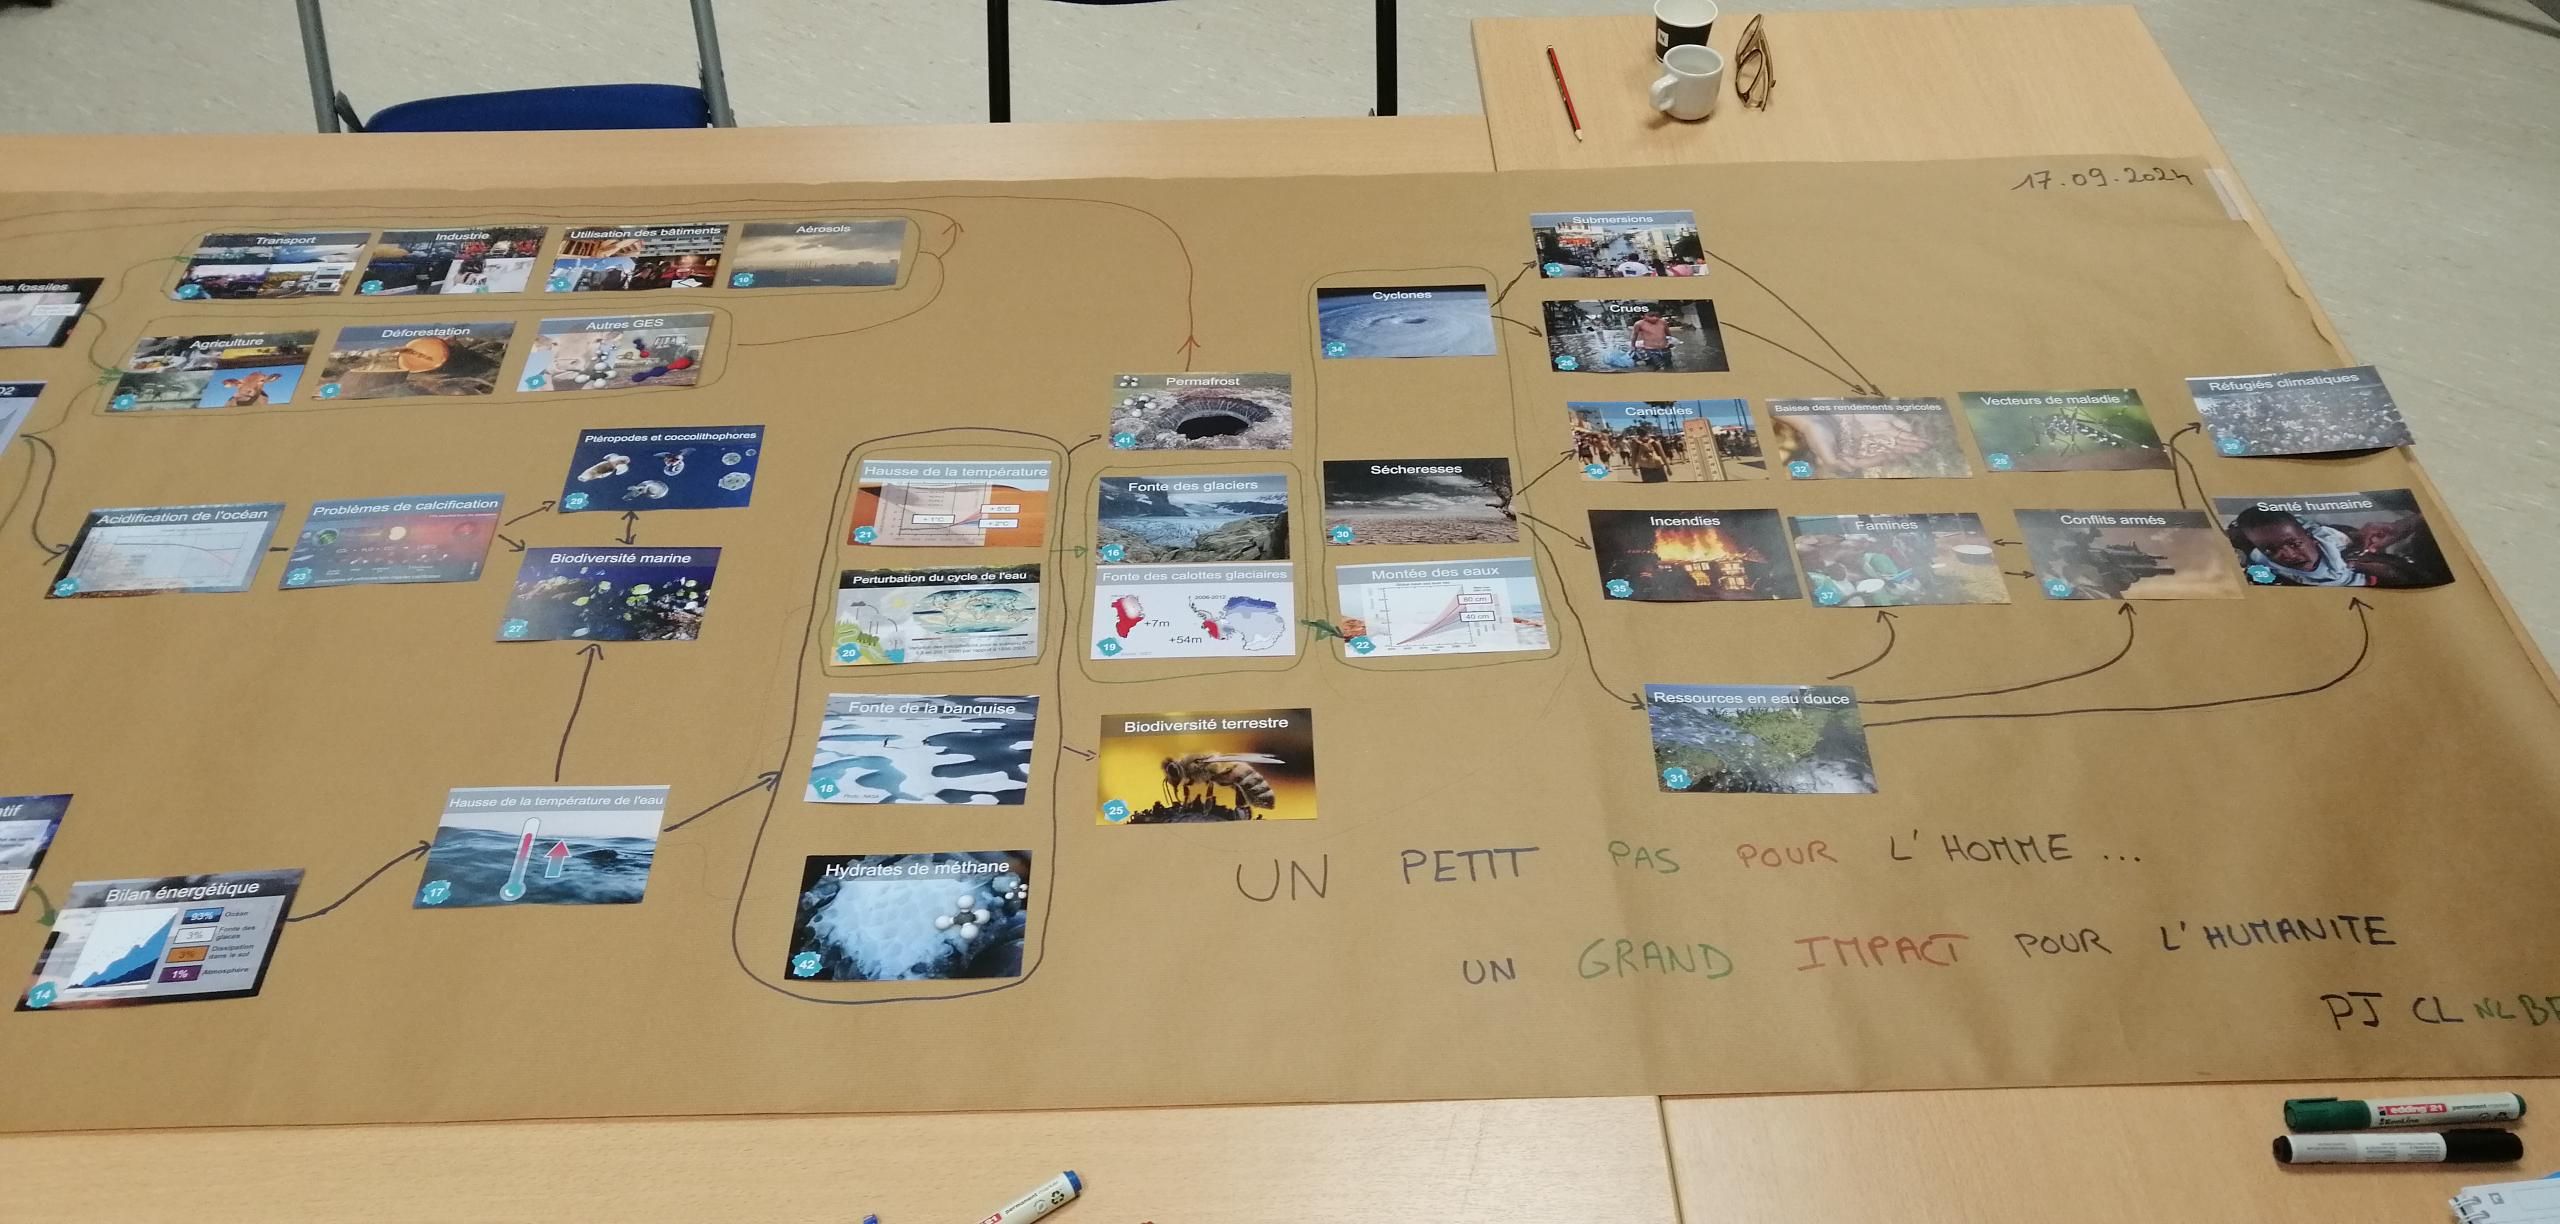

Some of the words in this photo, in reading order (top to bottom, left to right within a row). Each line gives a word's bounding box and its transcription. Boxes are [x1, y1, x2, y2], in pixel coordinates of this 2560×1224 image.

[1573, 215, 1654, 225] Submersions
[570, 228, 635, 239] Utilisation
[638, 228, 657, 238] des
[660, 225, 721, 237] bâtiments
[796, 224, 850, 234] Aérosols
[435, 231, 490, 241] Industrie
[256, 236, 316, 248] Transport
[738, 276, 749, 284] 10
[18, 283, 69, 292] fossiles
[1372, 291, 1432, 300] Cyclones
[1610, 304, 1649, 313] Crues
[586, 320, 629, 330] Autres
[633, 318, 664, 328] GES
[381, 326, 470, 338] Déforestation
[190, 337, 264, 351] Agriculture
[1166, 377, 1240, 386] Permafrost
[2209, 380, 2273, 392] Réfugiés
[2277, 374, 2360, 389] climatiques
[1980, 396, 2042, 406] Vecteurs
[2044, 395, 2063, 405] de
[2066, 394, 2120, 404] maladie
[1625, 406, 1693, 417] Canicules
[1775, 404, 1810, 412] Baisse
[1833, 403, 1893, 411] rendements
[1896, 403, 1942, 412] agricoles
[584, 433, 648, 445] Ptéropodes
[650, 433, 662, 442] et
[664, 431, 757, 443] coccolithophores
[864, 466, 919, 477] Hausse
[921, 466, 941, 477] de
[945, 466, 958, 477] la
[961, 466, 1048, 479] température
[1371, 464, 1463, 475] Sécheresses
[1128, 482, 1169, 492] Fonte
[1173, 481, 1199, 491] des
[1203, 480, 1258, 492] glaciers
[569, 497, 584, 505] 29
[2256, 501, 2302, 513] Santé
[2305, 499, 2373, 512] humaine
[312, 505, 389, 516] Problèmes
[393, 502, 412, 512] de
[415, 499, 498, 511] calcification
[96, 511, 188, 525] Acidification
[191, 510, 213, 522] de
[216, 508, 268, 521] l'océan
[1650, 515, 1720, 527] Incendies
[2060, 514, 2117, 525] Conflits
[2120, 515, 2167, 525] armés
[1856, 519, 1918, 532] Famines
[550, 552, 636, 565] Biodiversité
[640, 553, 692, 564] marine
[1108, 549, 1120, 557] 16
[292, 573, 307, 581] 23
[853, 574, 926, 585] Perturbation
[928, 573, 945, 583] du
[947, 572, 977, 583] cycle
[980, 572, 996, 581] de
[999, 571, 1027, 581] l'eau
[1103, 572, 1140, 582] Fonte
[1144, 571, 1167, 581] des
[1170, 570, 1222, 581] calottes
[1225, 569, 1288, 581] glaciaires
[1371, 567, 1427, 580] Montée
[1431, 567, 1459, 578] des
[1463, 566, 1500, 576] eaux
[59, 583, 74, 592] 24
[1612, 584, 1627, 593] 35
[2052, 584, 2066, 592] 40
[1820, 591, 1835, 600] 37
[508, 624, 523, 633] 27
[1168, 635, 1203, 644] +54m
[1355, 641, 1370, 649] 22
[1103, 643, 1116, 651] 19
[841, 649, 856, 657] 20
[1654, 691, 1743, 705] Ressources
[1747, 694, 1766, 704] en
[1772, 694, 1799, 705] eau
[1803, 692, 1850, 705] douce
[849, 701, 894, 714] Fonte
[899, 702, 919, 714] de
[924, 702, 938, 714] la
[943, 702, 1016, 717] banquise
[1124, 719, 1217, 733] Biodiversité
[1222, 717, 1288, 729] terrestre
[1670, 773, 1684, 783] 31
[819, 784, 833, 793] 18
[448, 797, 497, 808] Hausse
[500, 796, 517, 807] de
[520, 796, 532, 806] la
[535, 794, 611, 808] température
[614, 795, 630, 806] de
[633, 794, 664, 805] l'eau
[1109, 806, 1123, 815] 25
[825, 863, 903, 879] Hydrates
[908, 862, 929, 876] de
[934, 860, 1010, 875] méthane
[1236, 853, 1329, 902] UN
[1401, 847, 1539, 885] PETIT
[1608, 840, 1680, 875] PAS
[1736, 843, 1838, 870] POUR
[105, 887, 151, 903] Bilan
[155, 881, 261, 902] énergétique
[430, 888, 445, 896] 17
[1463, 957, 1516, 986] UN
[1578, 937, 1734, 980] GRAND
[1793, 931, 1969, 971] IMPACT
[2016, 928, 2113, 960] POUR
[799, 960, 816, 970] 42
[171, 969, 189, 979] 1%
[34, 988, 51, 999] 14
[2390, 1105, 2428, 1115] edding
